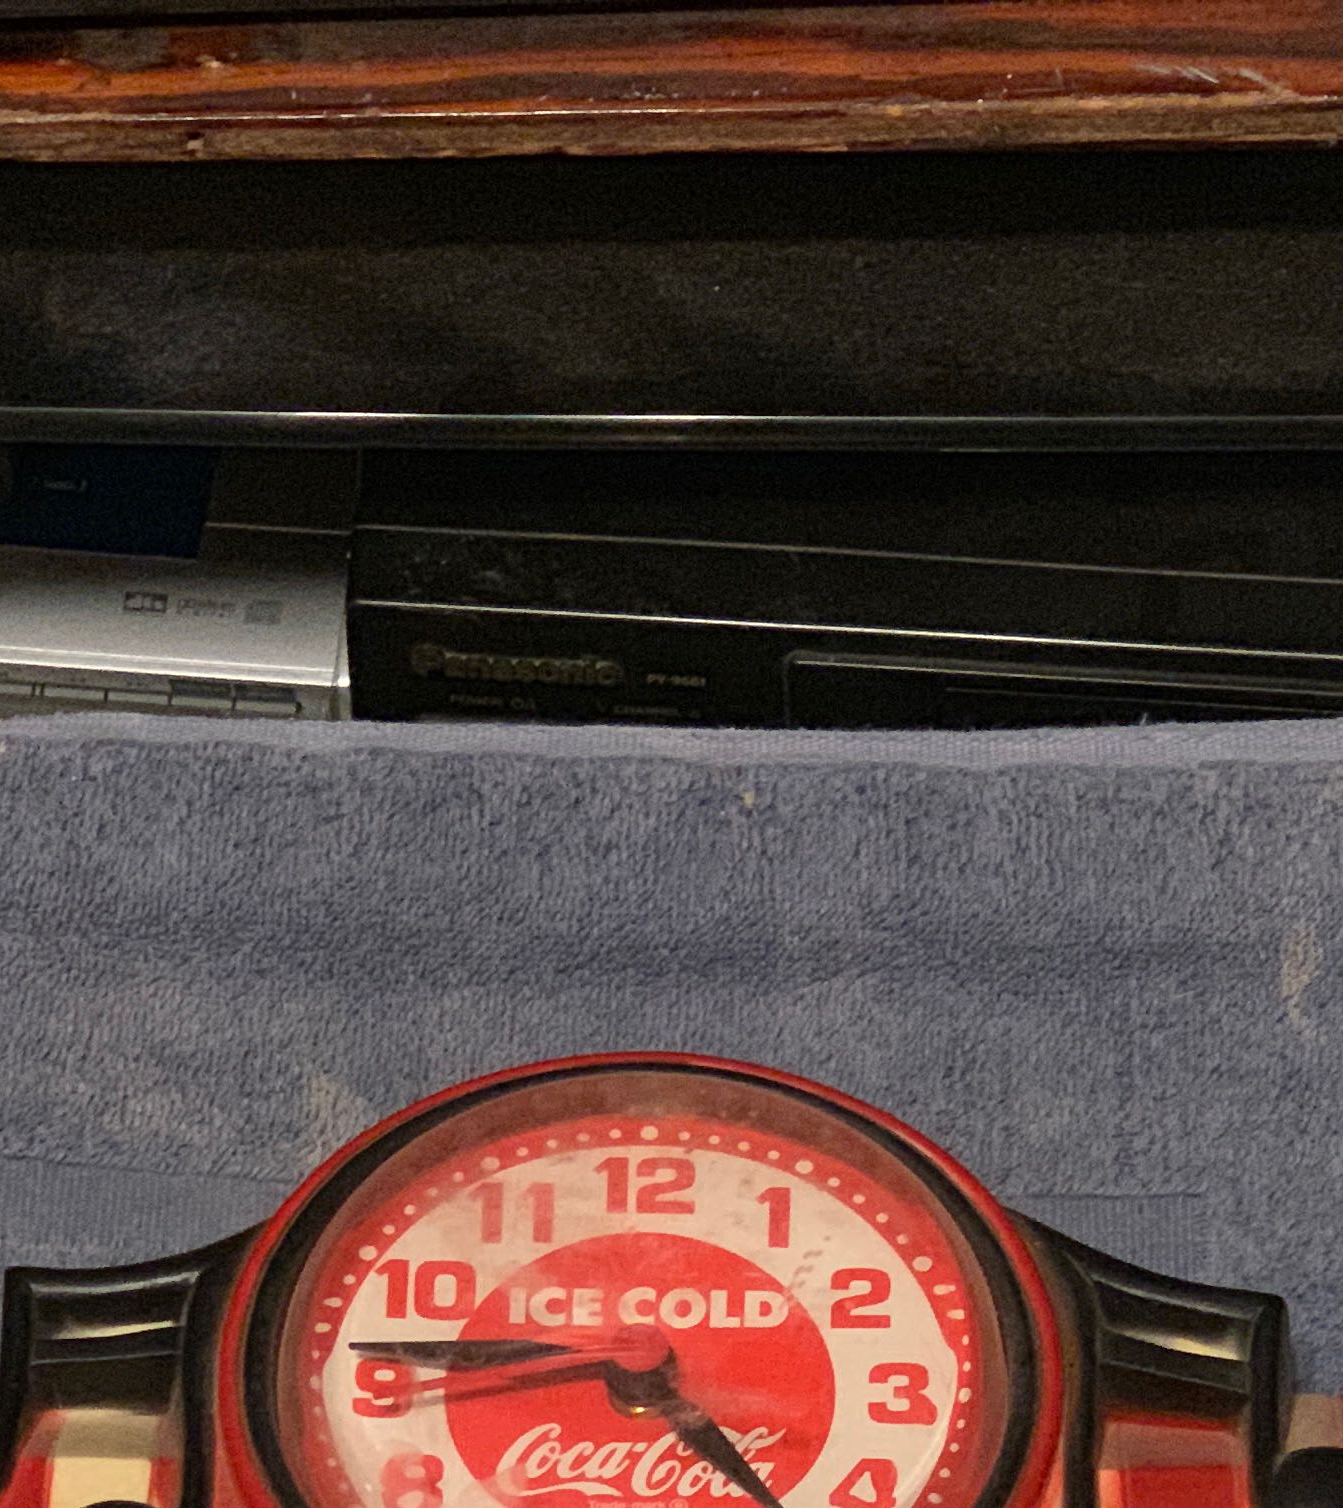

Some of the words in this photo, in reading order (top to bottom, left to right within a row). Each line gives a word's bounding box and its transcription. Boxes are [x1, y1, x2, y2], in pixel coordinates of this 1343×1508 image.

[468, 1182, 555, 1244] 11
[594, 1157, 696, 1214] 12
[757, 1186, 791, 1248] 1
[376, 1259, 477, 1321] 10
[508, 1286, 604, 1327] ICE
[617, 1286, 790, 1329] COLD
[829, 1268, 891, 1329] 2
[352, 1358, 414, 1417] 9
[867, 1362, 937, 1425] 3
